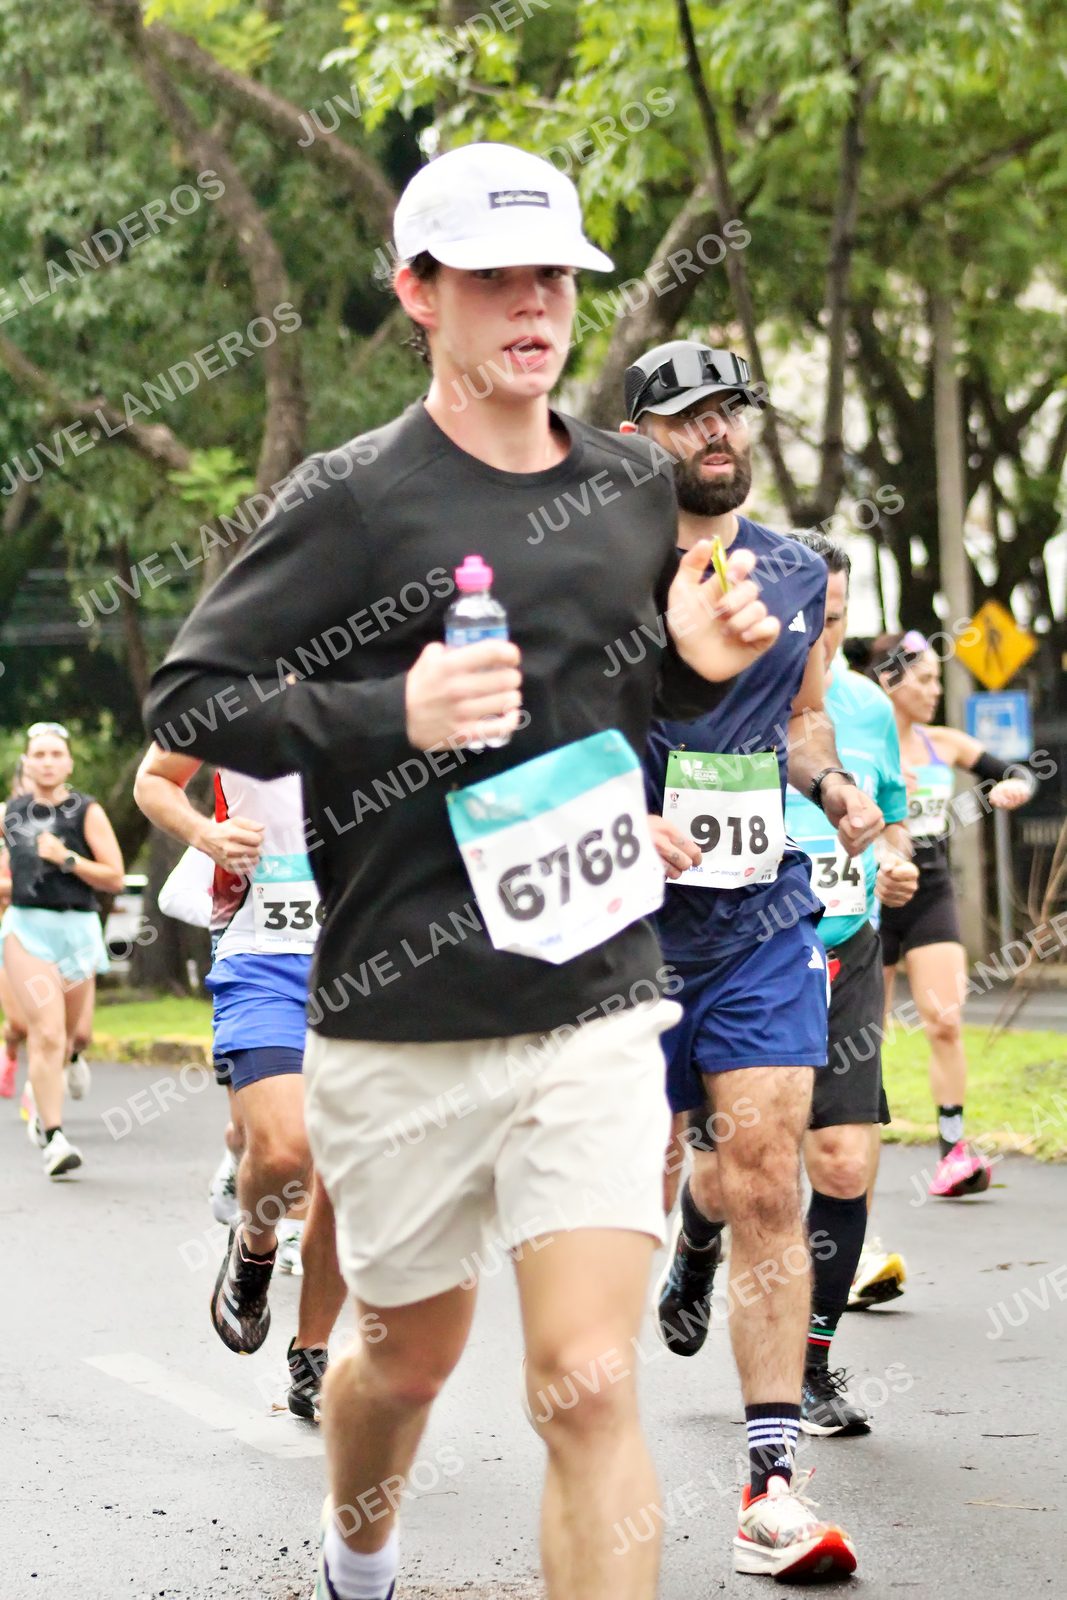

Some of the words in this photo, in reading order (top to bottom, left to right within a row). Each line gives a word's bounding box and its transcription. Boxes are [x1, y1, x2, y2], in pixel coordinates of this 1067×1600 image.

[690, 814, 769, 856] 918
[498, 812, 641, 921] 6768
[817, 857, 861, 889] 34
[263, 901, 328, 930] 336
